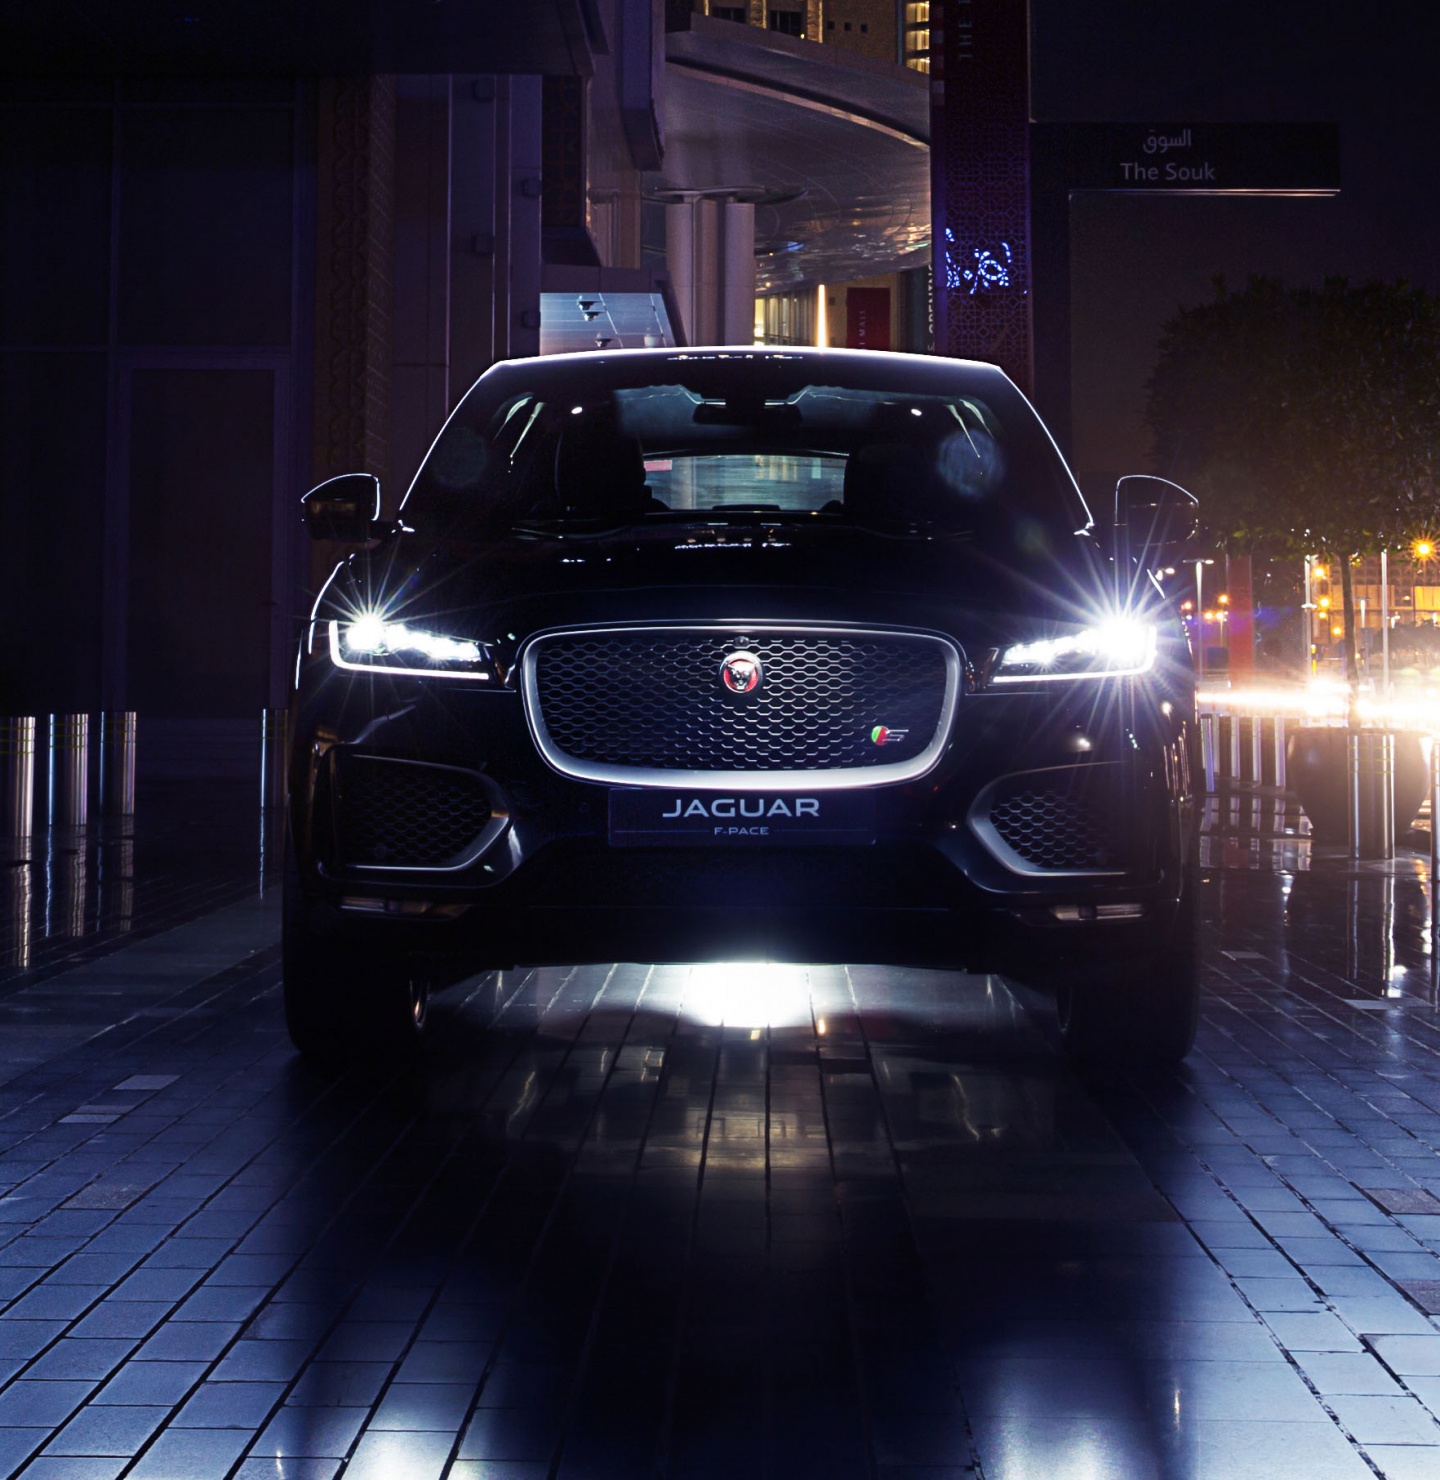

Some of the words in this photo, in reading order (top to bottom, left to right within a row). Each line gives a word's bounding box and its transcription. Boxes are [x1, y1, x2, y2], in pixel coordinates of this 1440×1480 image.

[956, 17, 974, 62] THE
[1142, 128, 1192, 154] السوق
[1120, 161, 1159, 181] The
[1164, 161, 1217, 181] Souk
[662, 798, 821, 818] JAGUAR
[713, 826, 770, 836] F-PACE
